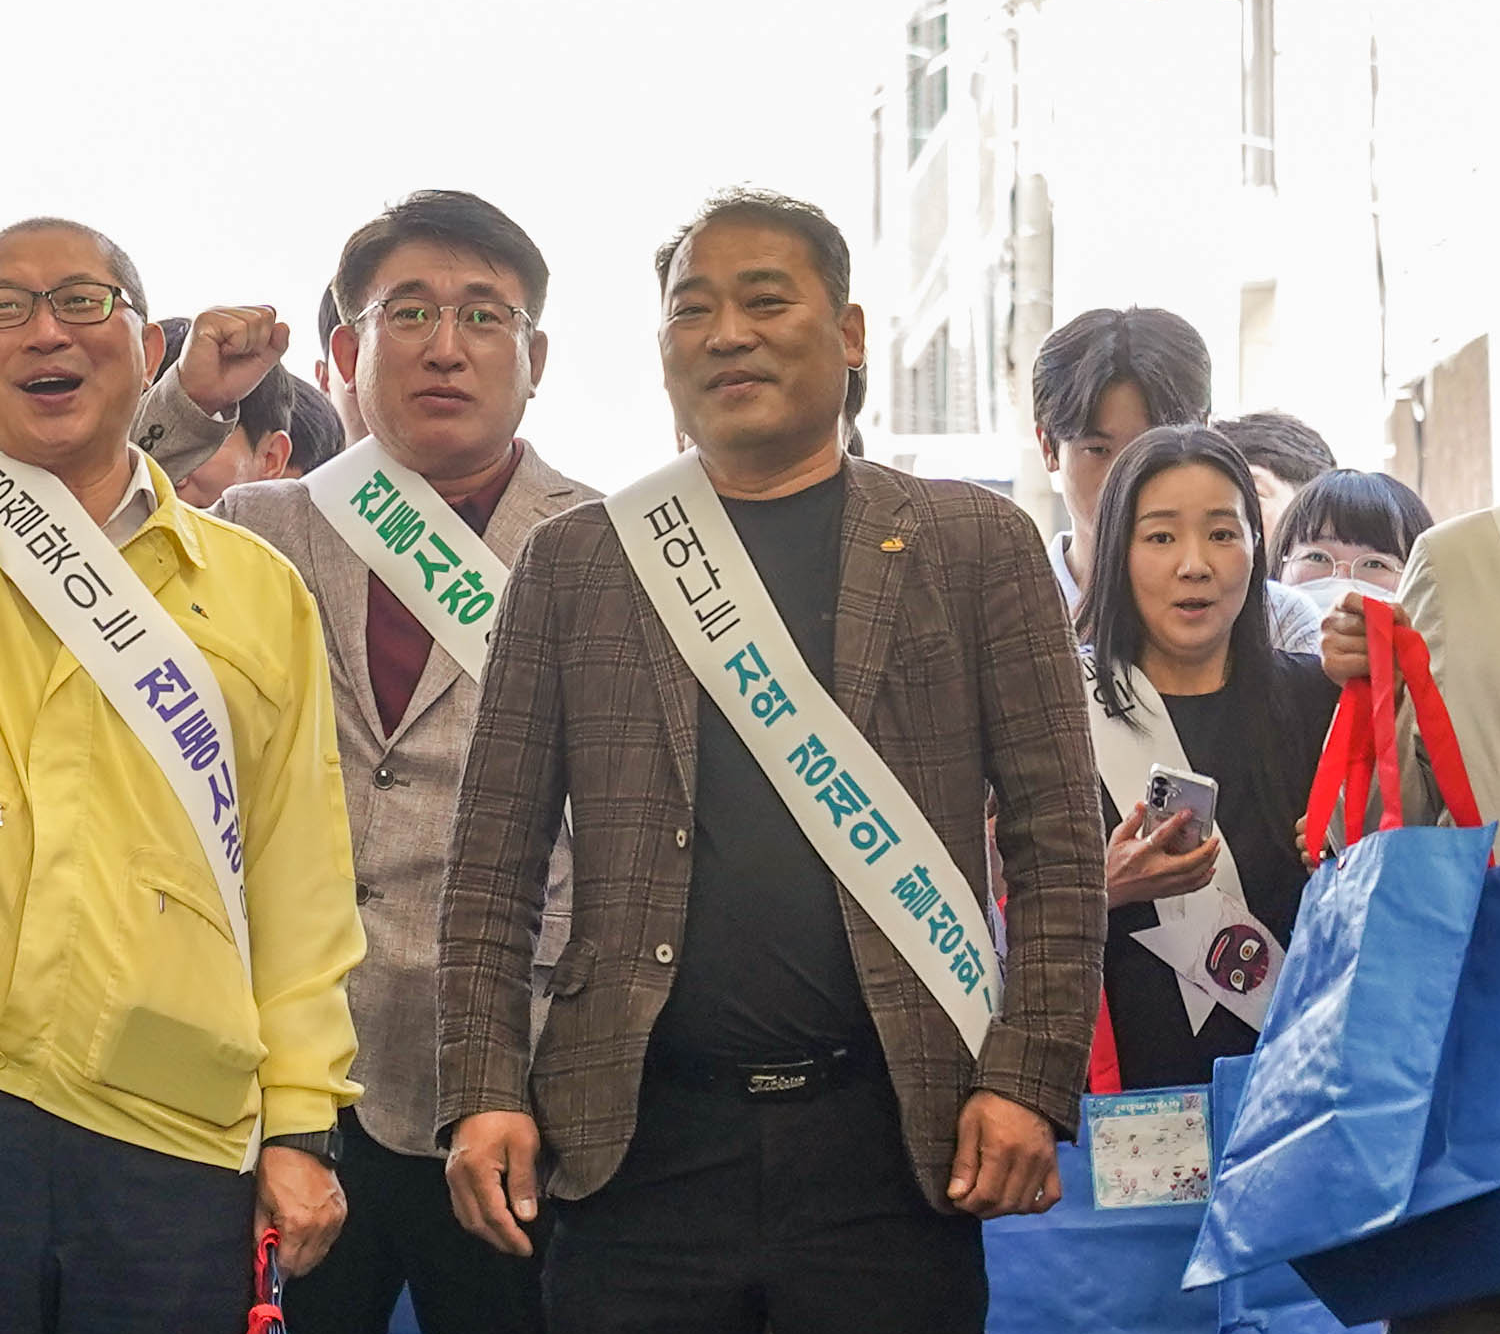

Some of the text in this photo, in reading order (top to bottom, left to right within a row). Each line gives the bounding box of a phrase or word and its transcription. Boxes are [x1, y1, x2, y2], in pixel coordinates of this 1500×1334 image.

[350, 468, 498, 626] 전통시장
[134, 657, 244, 876] 전통시장
[643, 494, 742, 644] 피어나는
[723, 640, 799, 729] 지역
[786, 732, 902, 865] 경제의
